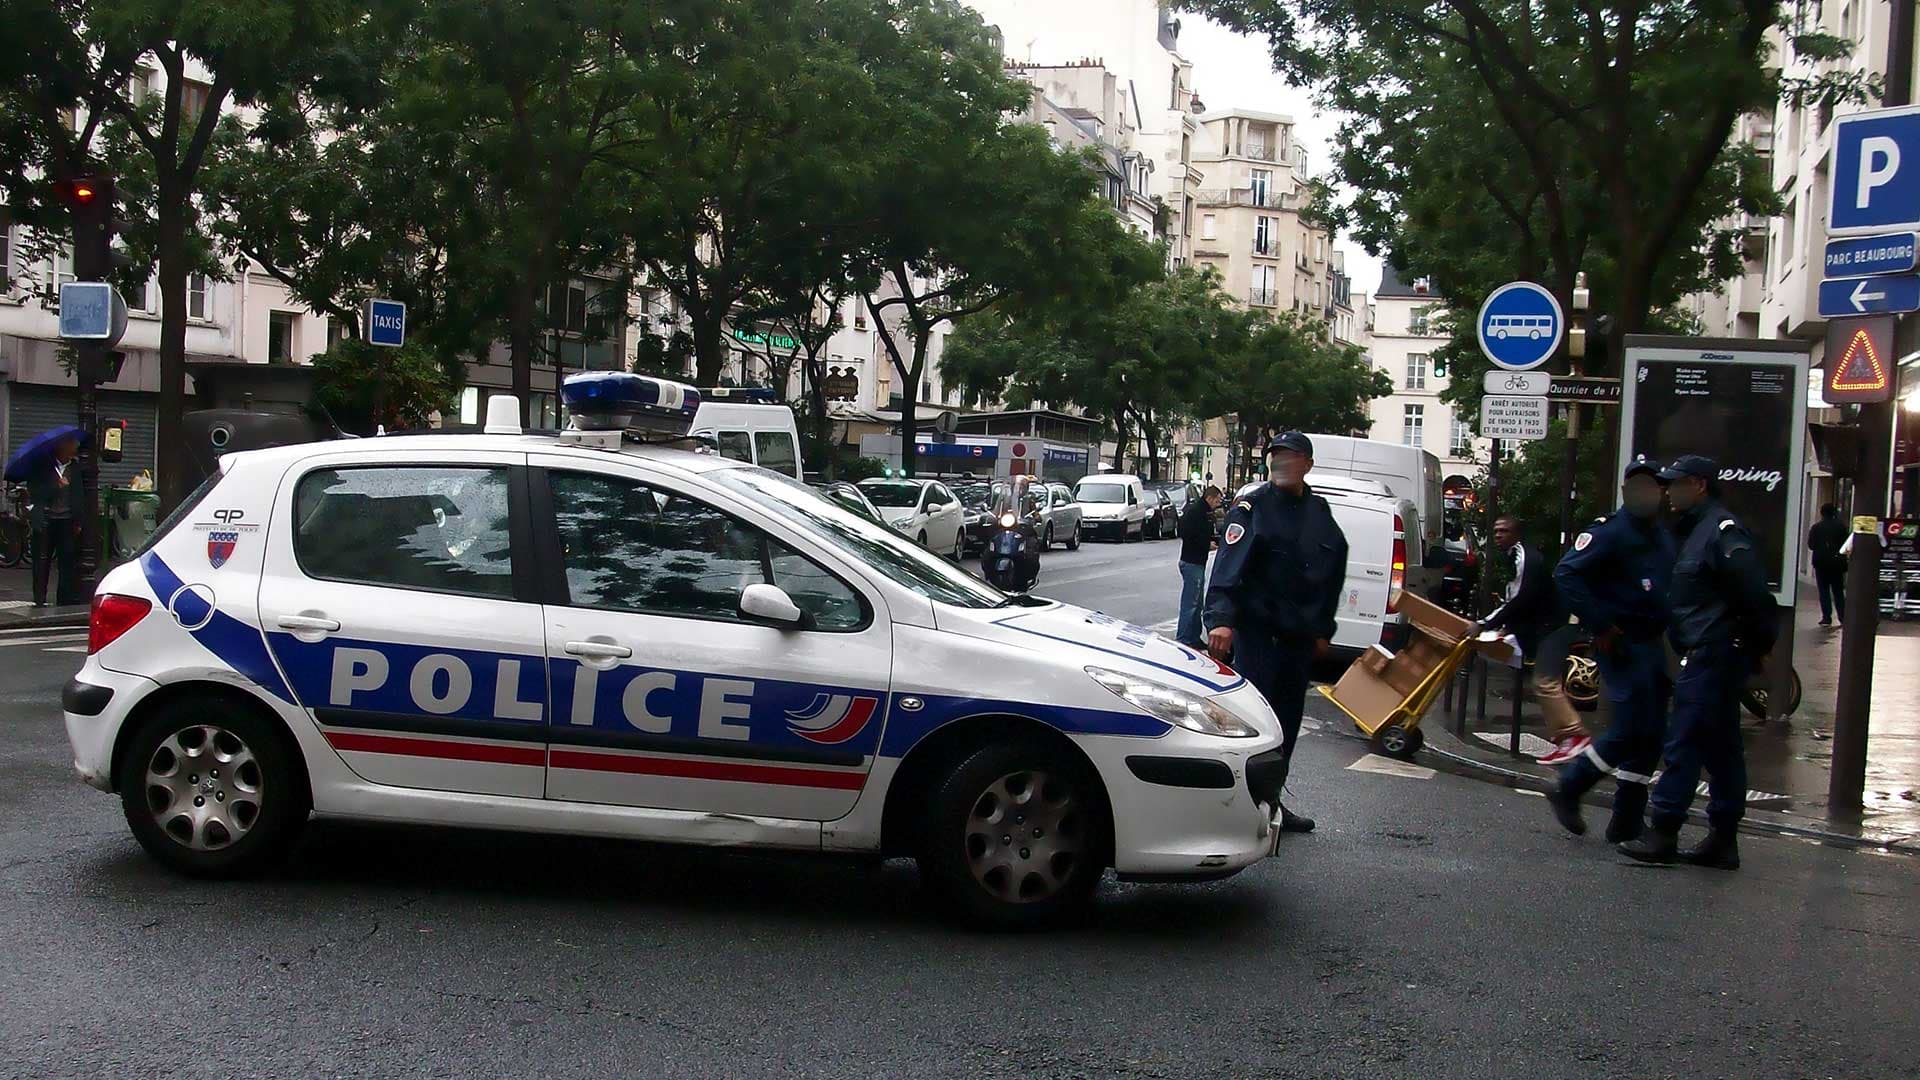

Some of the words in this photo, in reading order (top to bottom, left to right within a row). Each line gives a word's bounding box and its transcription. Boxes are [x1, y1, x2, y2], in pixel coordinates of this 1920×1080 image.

[1856, 136, 1900, 209] P
[1826, 251, 1852, 266] PARC
[1854, 245, 1912, 264] BEAUBOURG
[374, 314, 402, 330] TAXIS
[1550, 383, 1589, 395] Quartier
[1593, 385, 1605, 395] de
[1718, 466, 1783, 492] ering
[329, 646, 756, 742] POLICE
